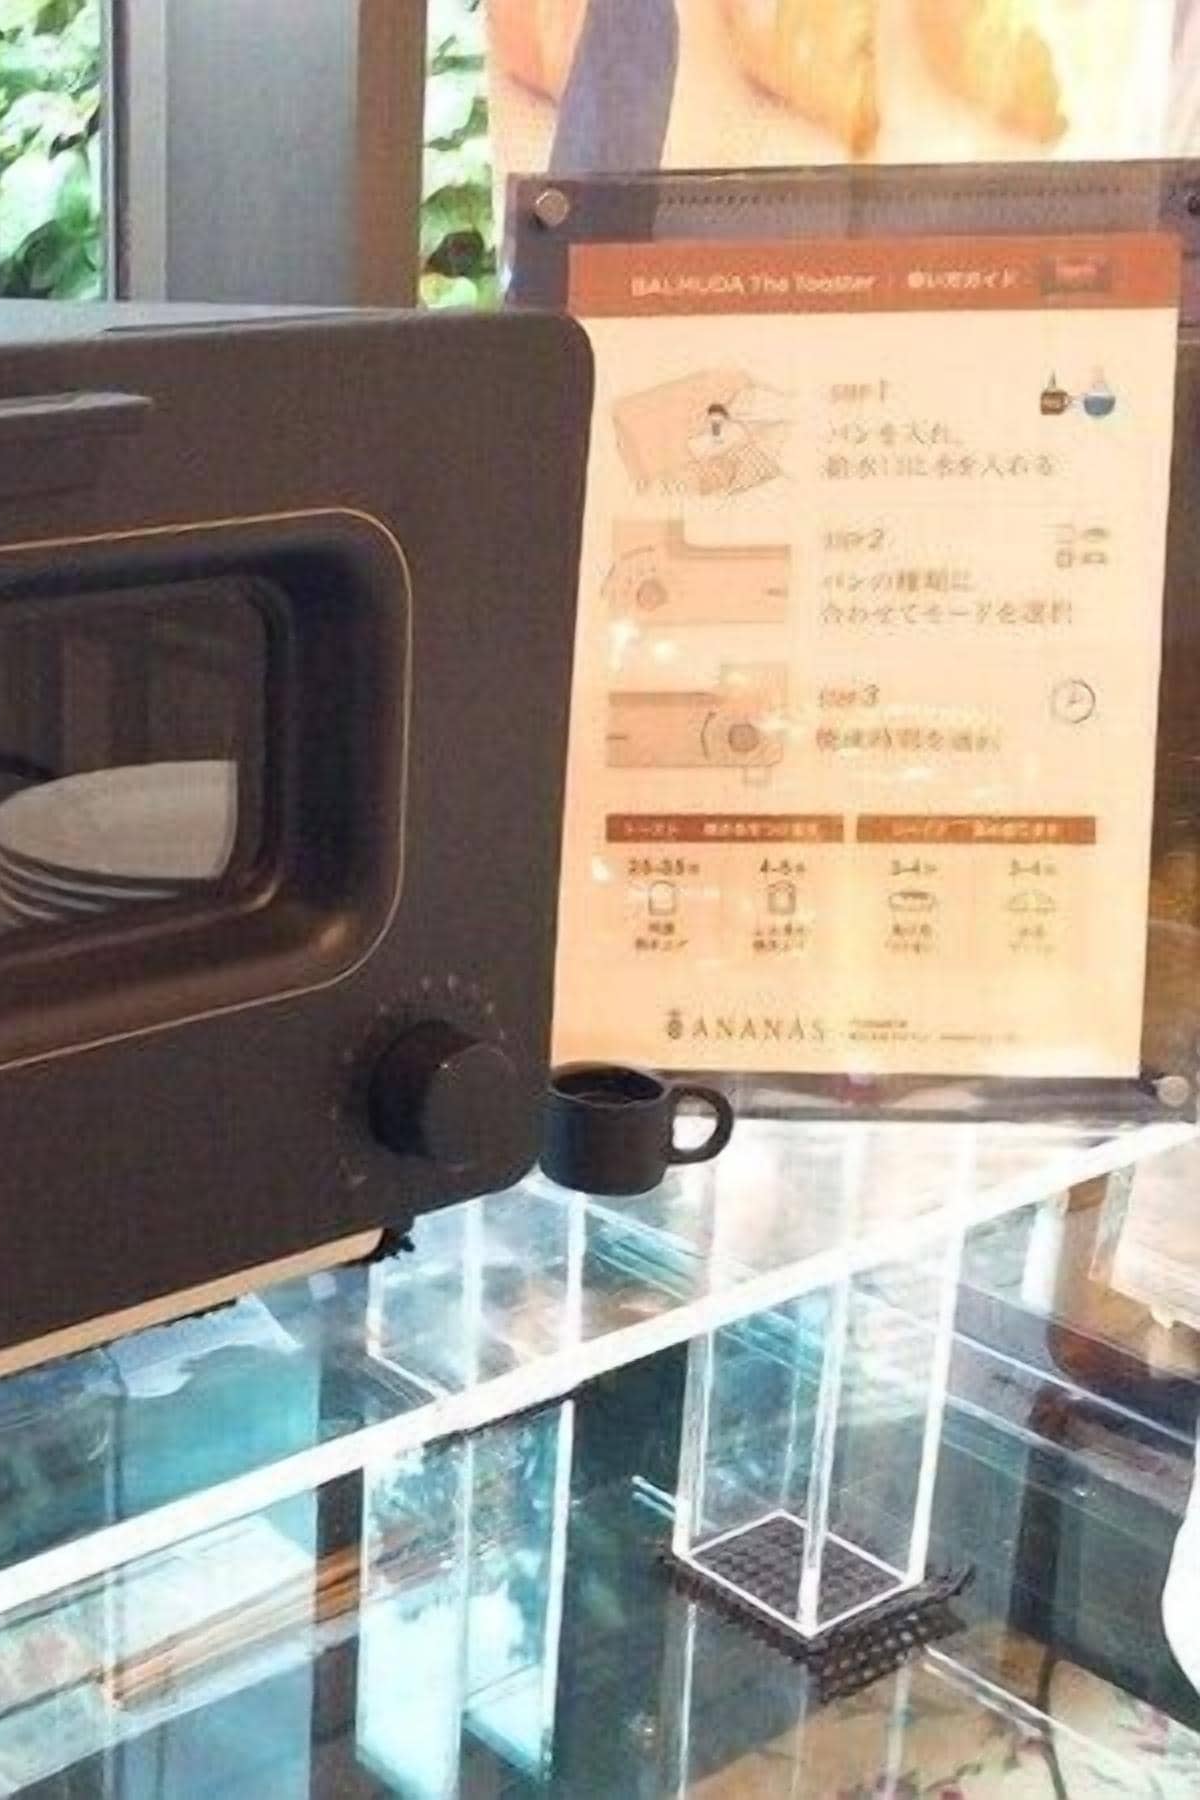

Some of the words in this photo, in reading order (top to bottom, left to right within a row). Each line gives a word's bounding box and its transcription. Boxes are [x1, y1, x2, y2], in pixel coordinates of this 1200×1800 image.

[631, 275, 744, 297] BALMUDA
[749, 275, 789, 293] The
[795, 273, 877, 293] Toaster
[691, 1016, 825, 1041] ANANAS
